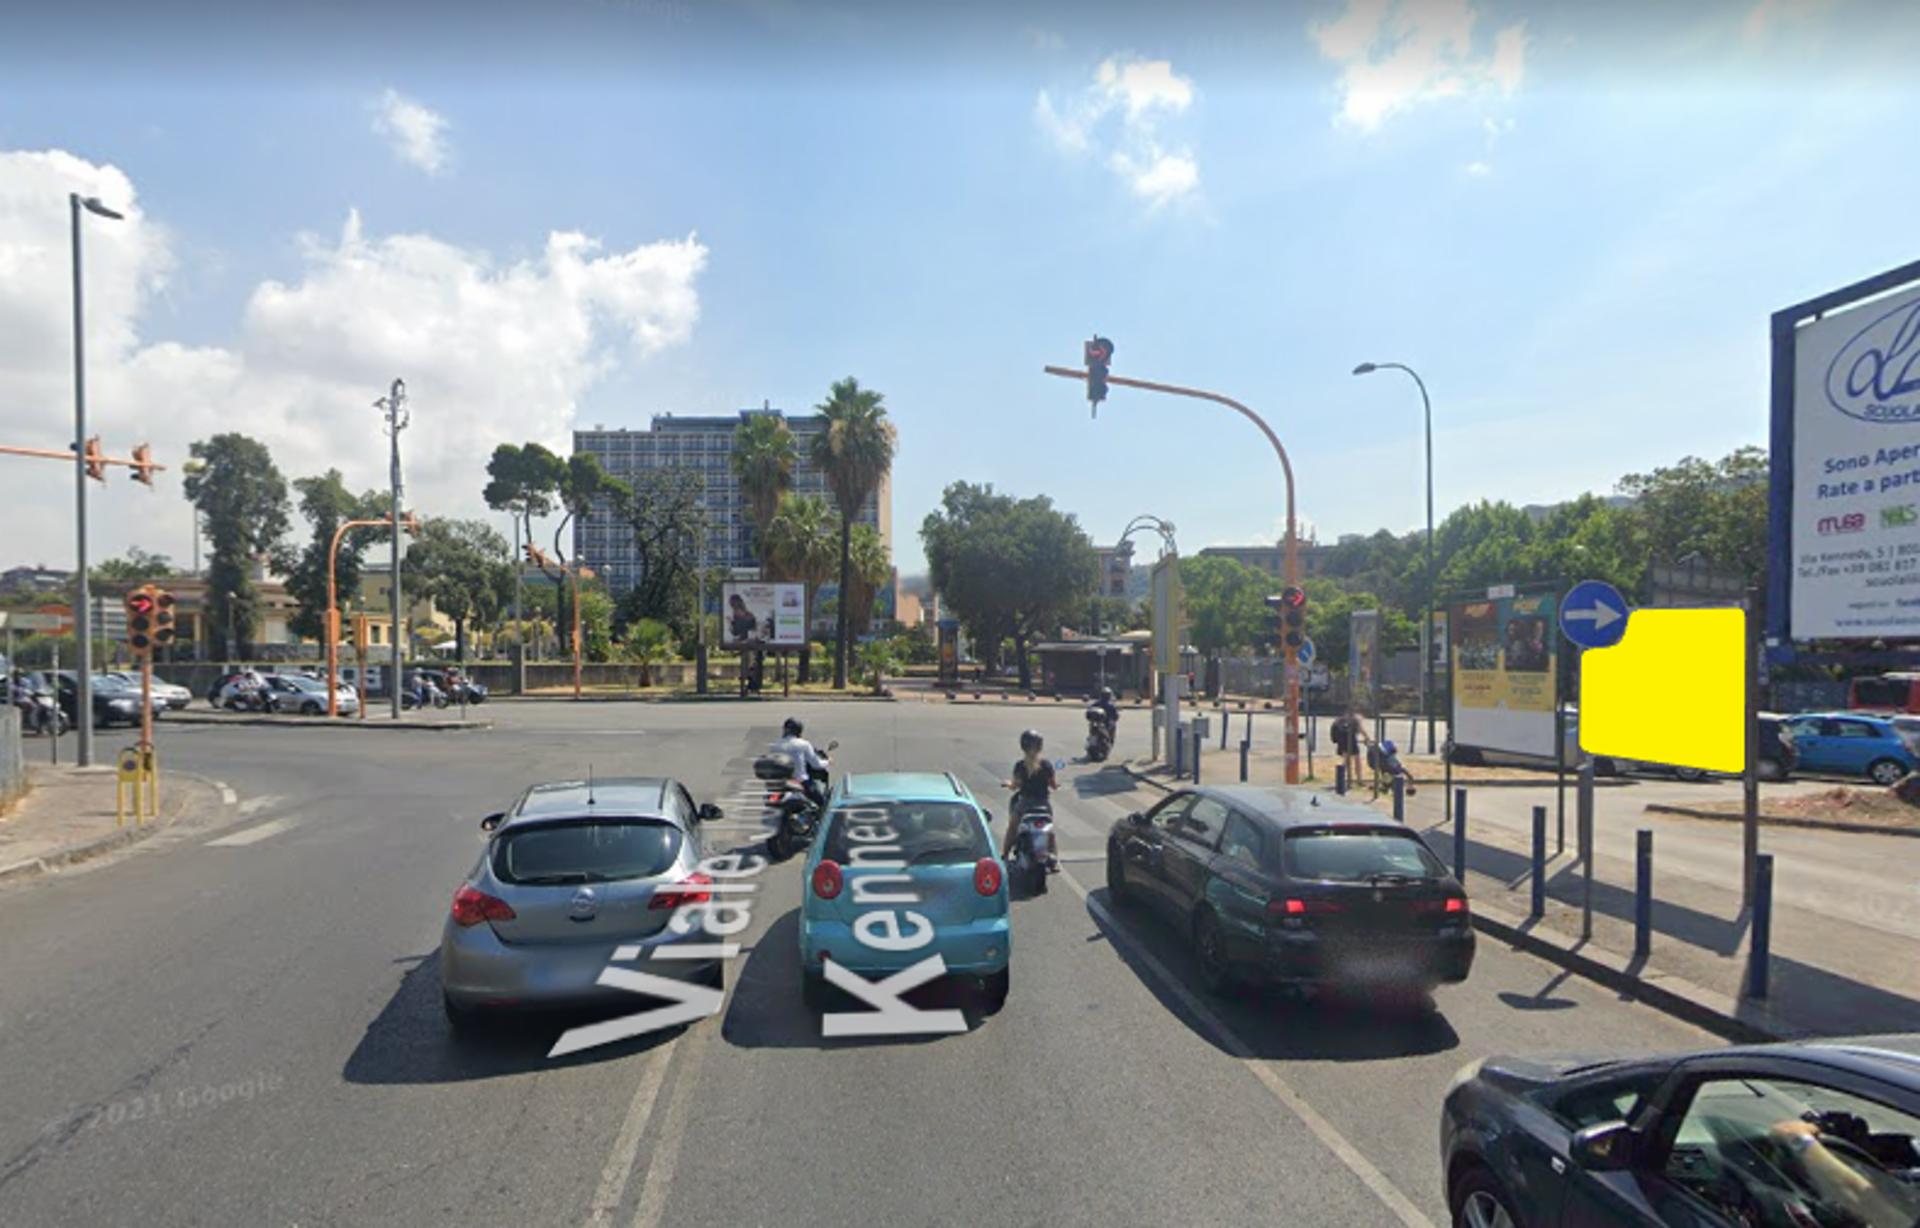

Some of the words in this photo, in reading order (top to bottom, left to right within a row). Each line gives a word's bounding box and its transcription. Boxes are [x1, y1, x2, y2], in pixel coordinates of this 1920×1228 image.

[1823, 455, 1870, 474] Sono
[1817, 482, 1859, 499] Rate
[1863, 479, 1875, 493] a
